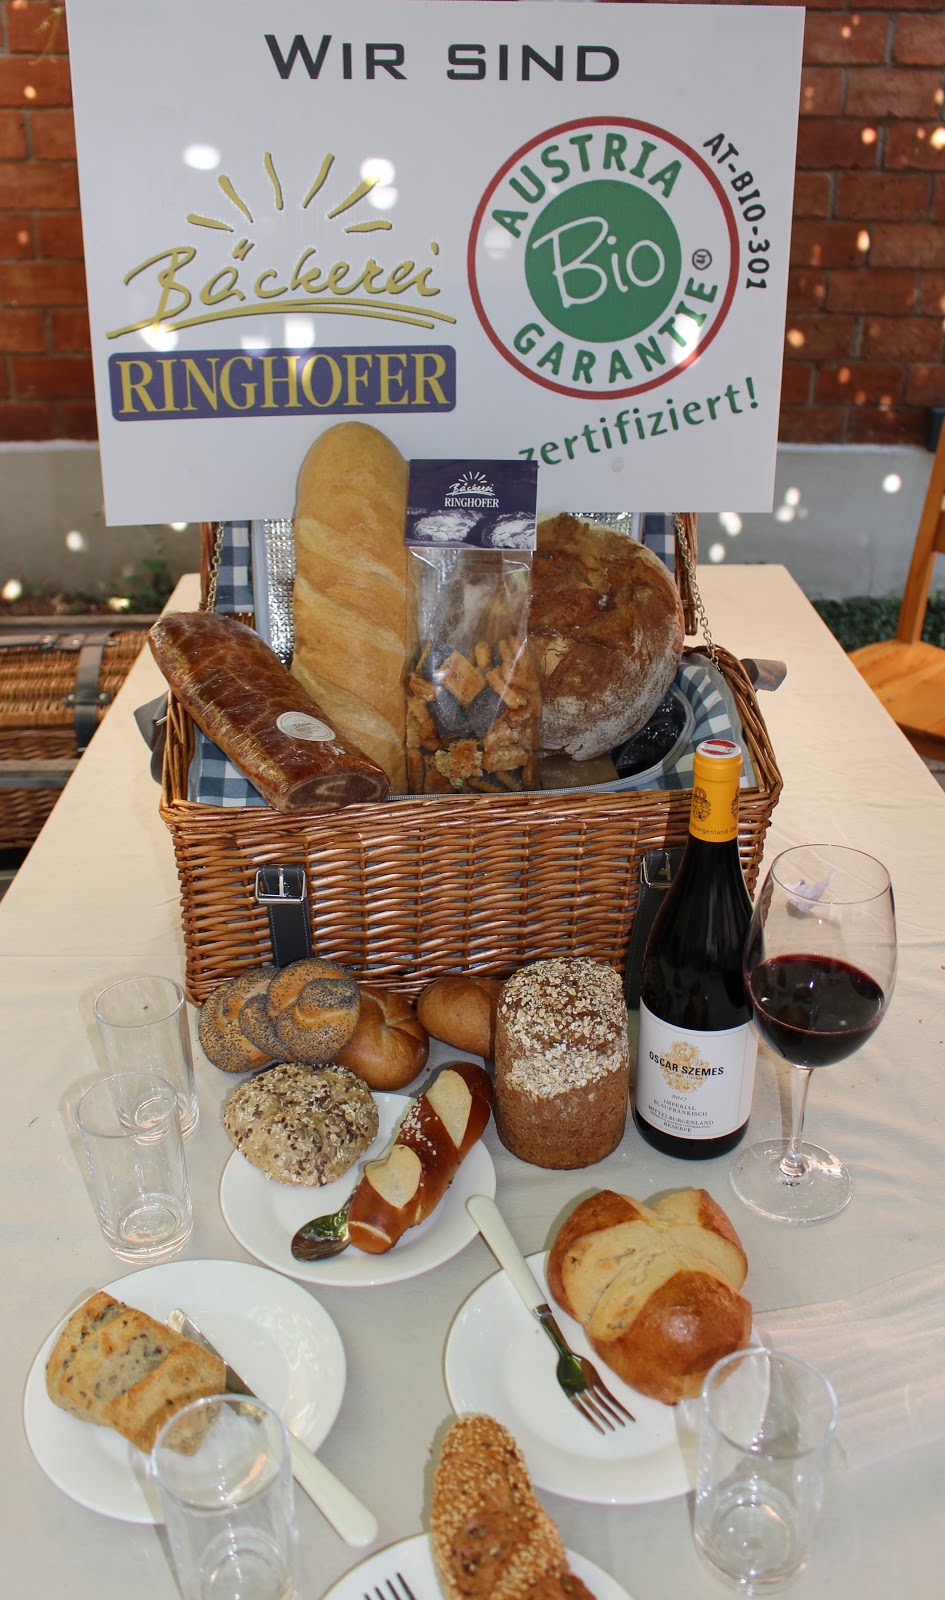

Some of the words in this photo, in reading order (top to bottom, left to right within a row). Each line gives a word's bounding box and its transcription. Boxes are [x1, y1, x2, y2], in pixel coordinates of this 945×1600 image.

[491, 133, 682, 239] AUSTRIA
[702, 132, 771, 291] AT-BIO-301
[123, 239, 441, 330] Bäckerei
[532, 216, 666, 310] Bio
[513, 276, 719, 385] GARANTIE
[115, 352, 452, 415] RINGHOFER
[518, 376, 760, 468] zertifiziert!
[444, 497, 500, 508] RINGHOFER
[649, 1050, 679, 1072] OSCAR
[681, 1065, 725, 1076] SZEMES
[648, 1104, 714, 1126] MITTELBURGENLAND
[663, 1099, 697, 1111] IMPERIAL
[663, 1121, 692, 1133] RESERVE
